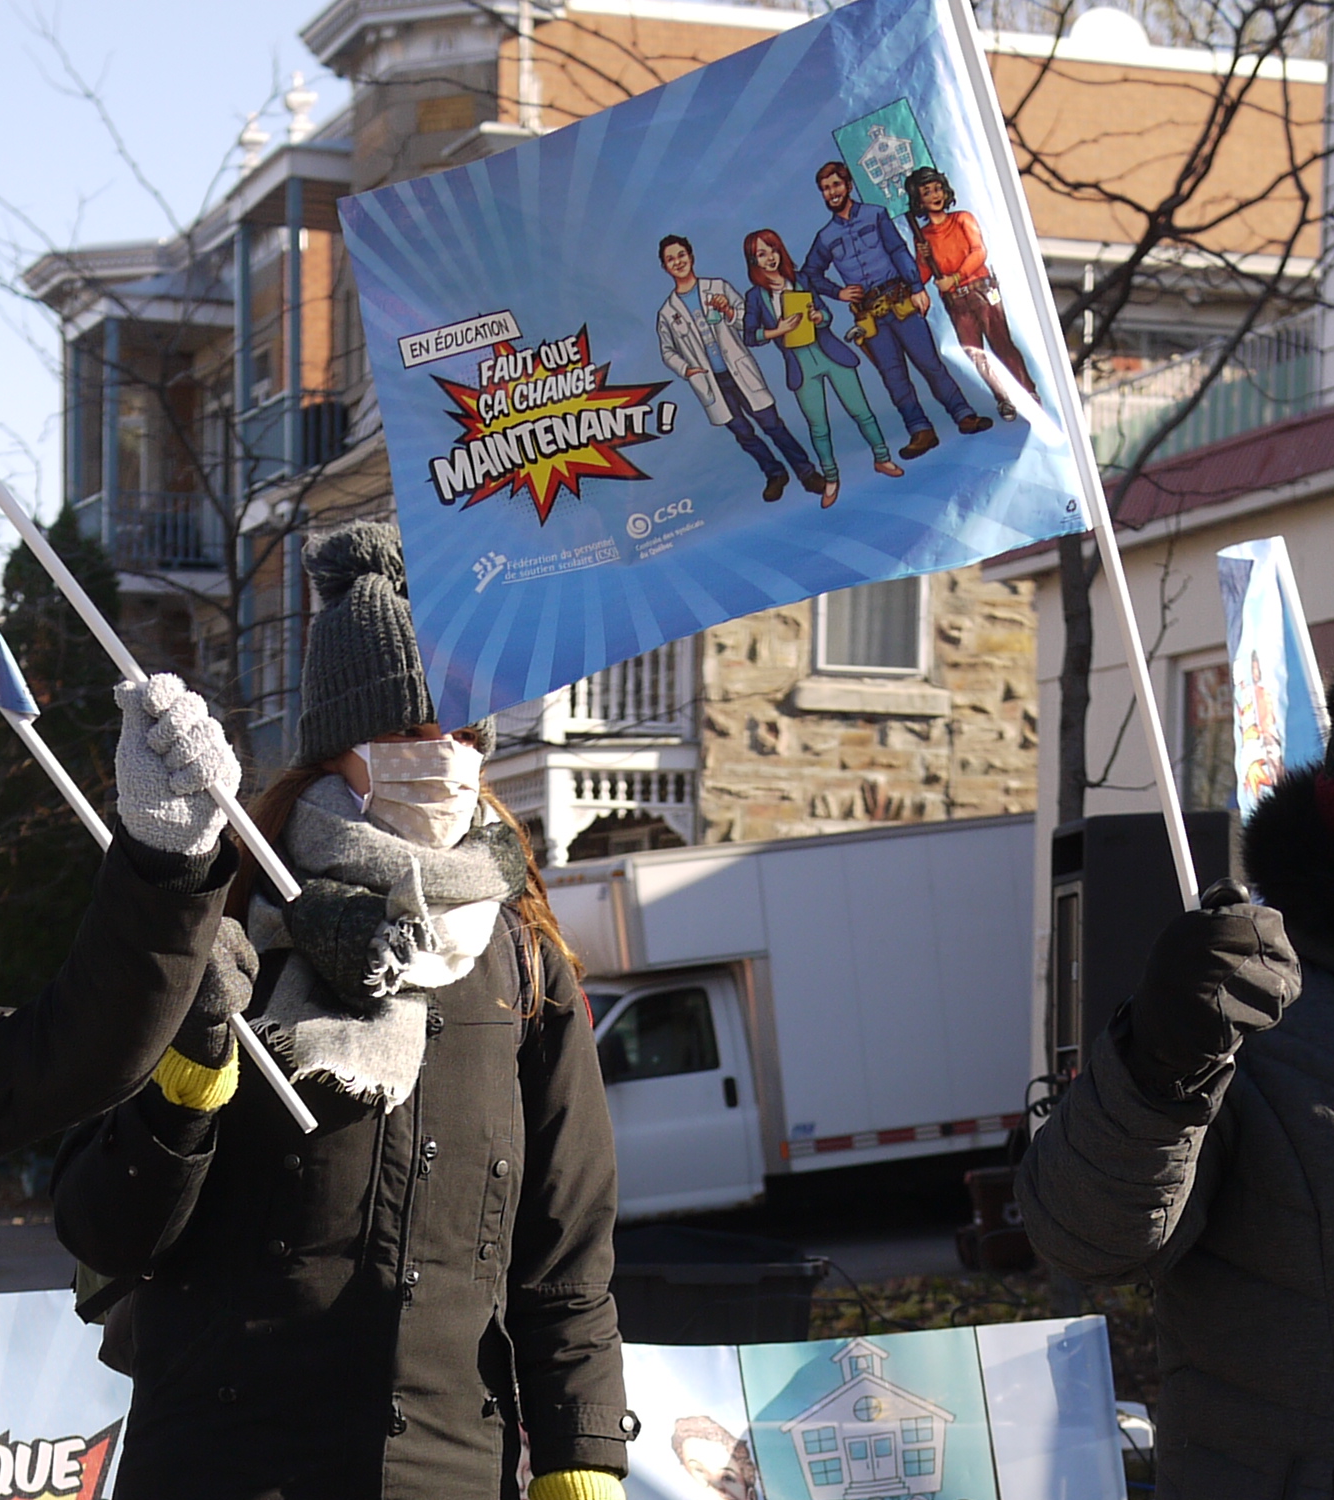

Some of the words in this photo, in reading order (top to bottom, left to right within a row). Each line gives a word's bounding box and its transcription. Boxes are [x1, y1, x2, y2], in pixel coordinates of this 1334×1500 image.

[409, 337, 430, 359] EN
[434, 317, 510, 353] ÉDUCATION
[480, 348, 534, 387] FAUT
[540, 336, 582, 371] QUE
[478, 388, 509, 425] ÇA
[513, 363, 597, 411] CHANGE
[654, 498, 695, 523] CSQ
[504, 571, 517, 580] de
[519, 565, 556, 578] soutien
[558, 555, 594, 570] scolaire
[507, 554, 558, 570] Fédération
[573, 535, 616, 558] personnel
